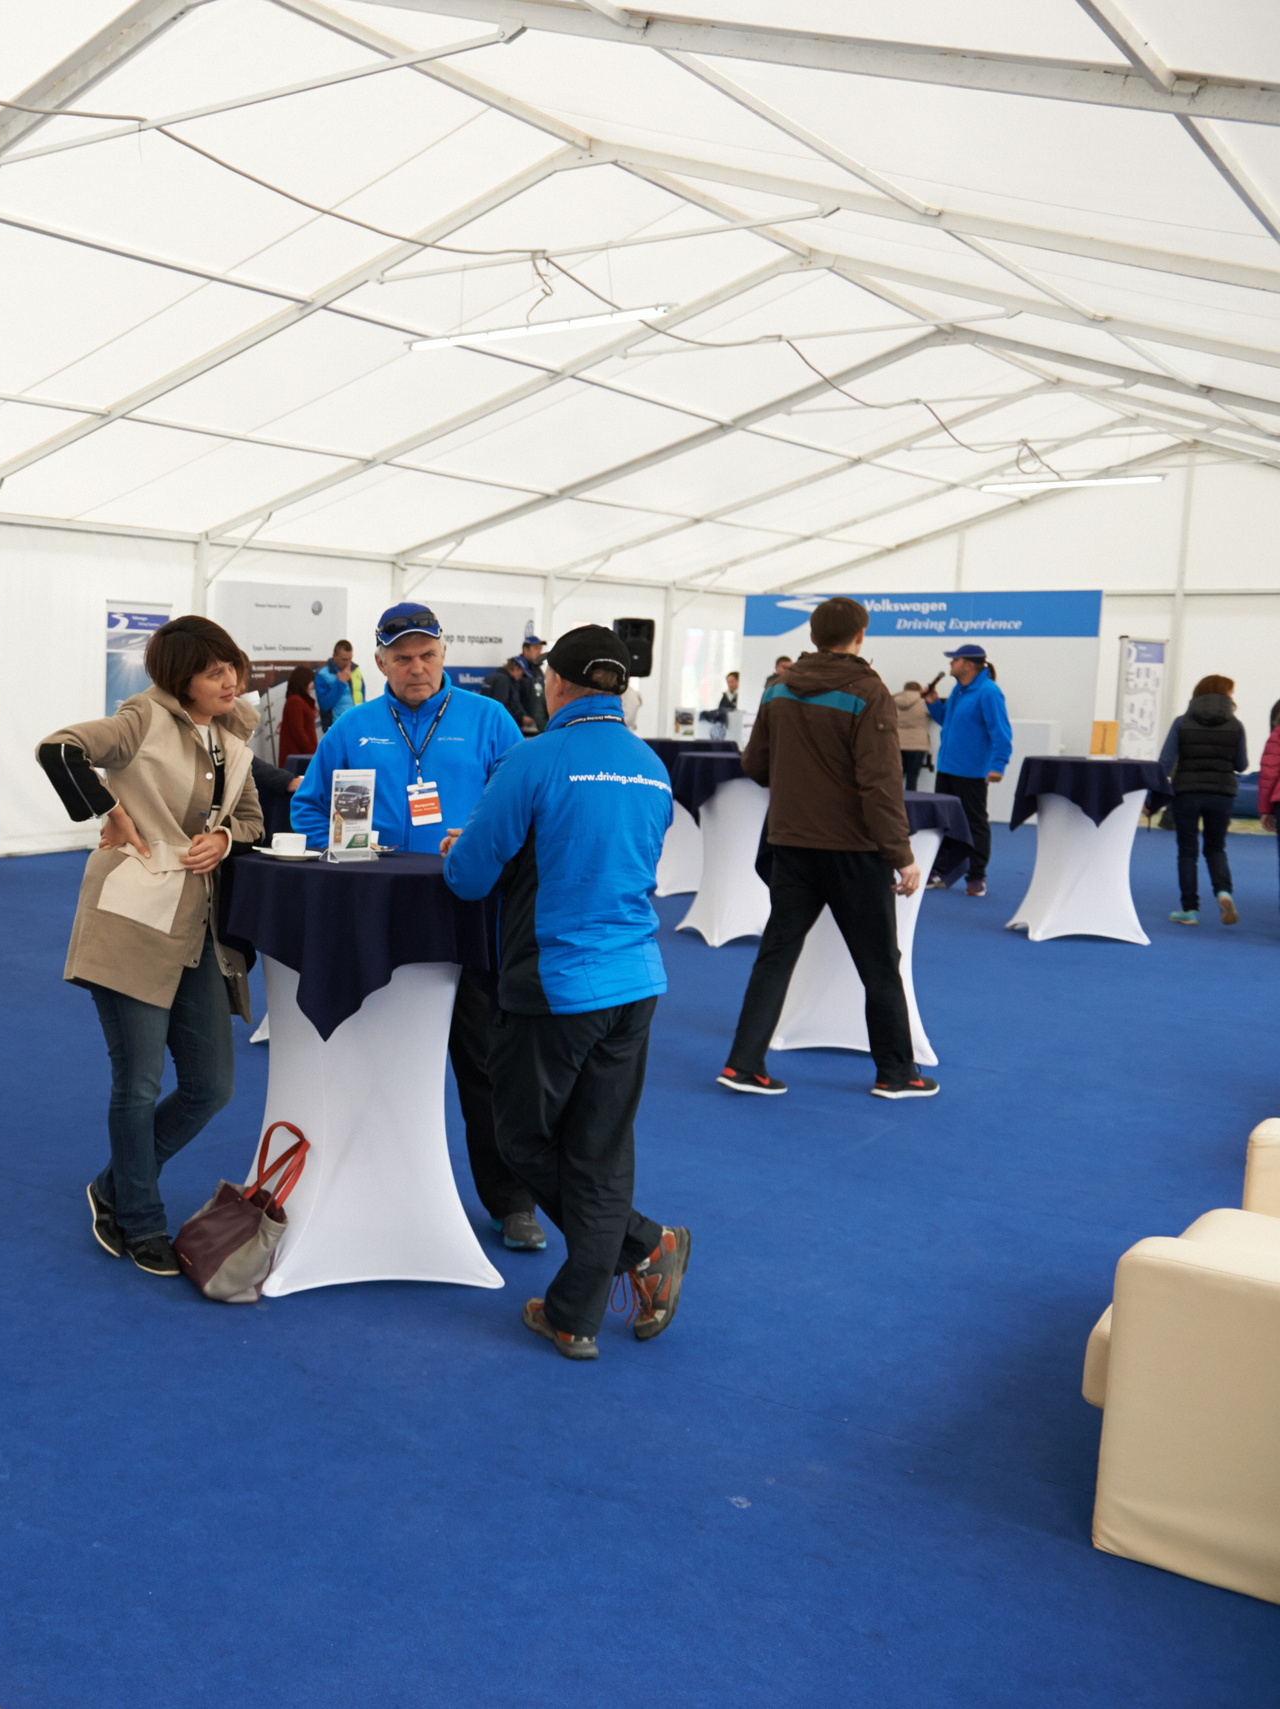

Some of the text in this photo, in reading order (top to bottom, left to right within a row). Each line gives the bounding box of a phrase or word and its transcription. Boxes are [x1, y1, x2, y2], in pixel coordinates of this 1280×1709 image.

[863, 598, 947, 614] Volkswagen
[896, 618, 1022, 632] Driving Experience
